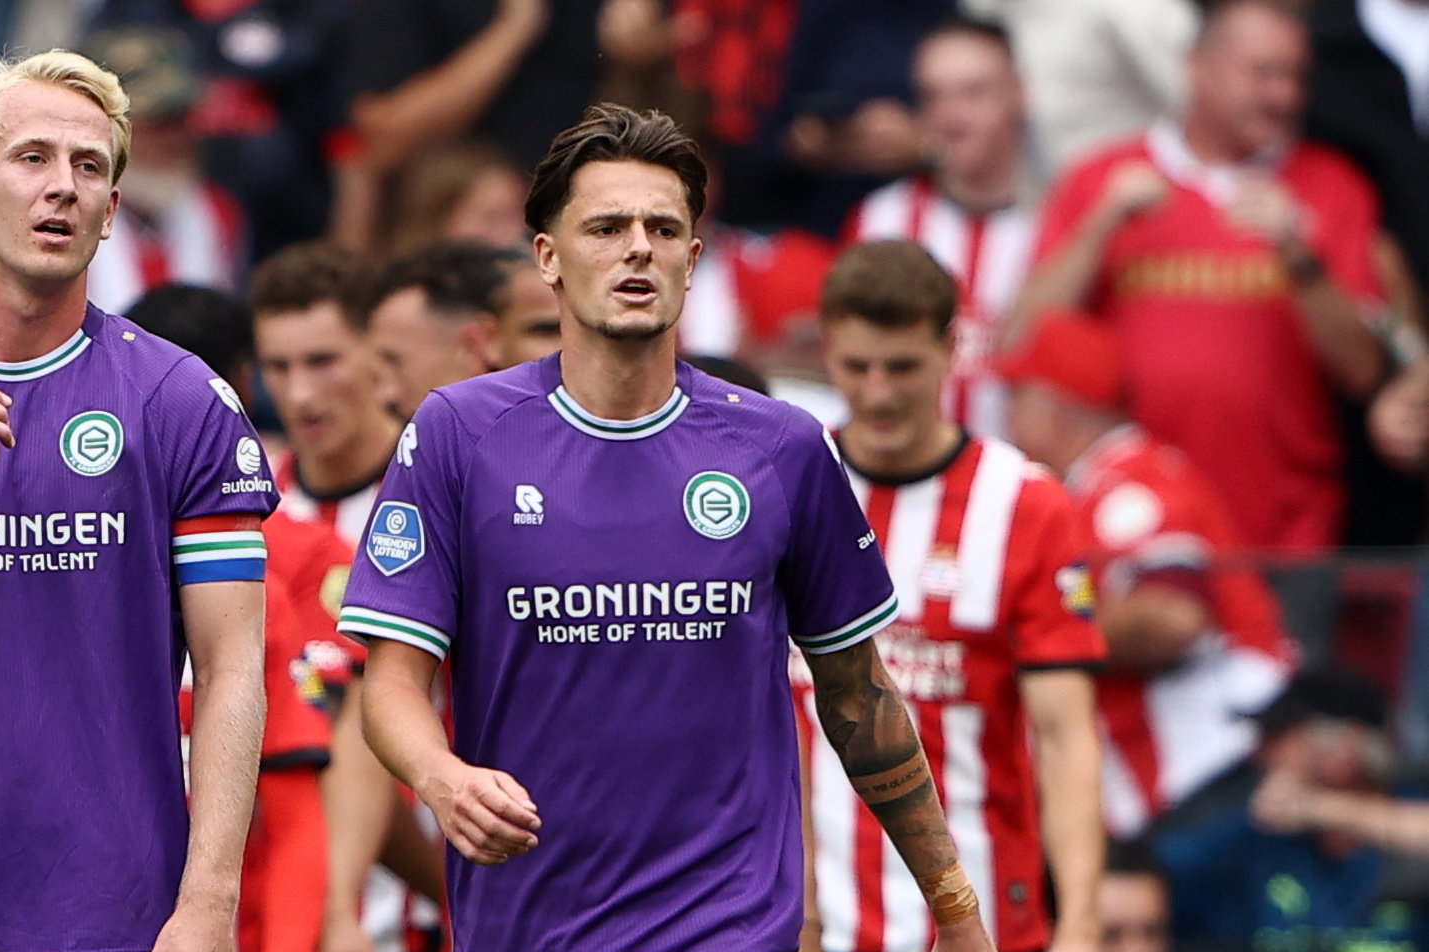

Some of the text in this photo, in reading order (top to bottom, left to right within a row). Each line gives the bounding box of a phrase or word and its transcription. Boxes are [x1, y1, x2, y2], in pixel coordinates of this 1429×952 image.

[513, 512, 544, 525] ROBEY
[372, 535, 417, 552] VRIENDEN
[19, 552, 98, 572] TALENT
[507, 581, 752, 620] GRONINGEN
[538, 621, 726, 643] HOME OF TALENT
